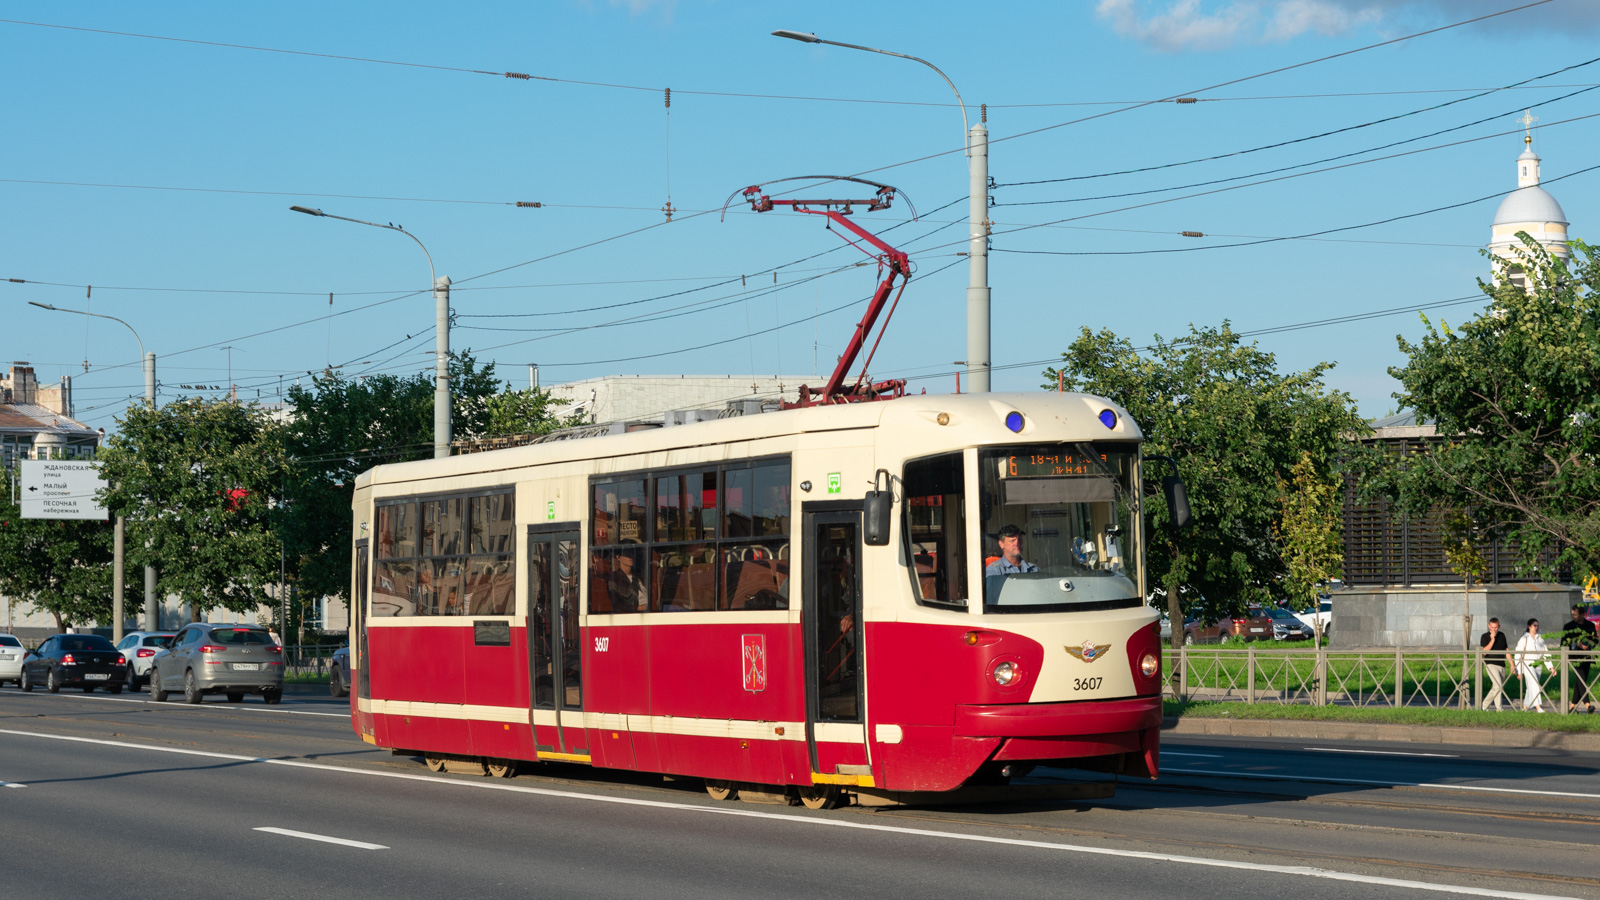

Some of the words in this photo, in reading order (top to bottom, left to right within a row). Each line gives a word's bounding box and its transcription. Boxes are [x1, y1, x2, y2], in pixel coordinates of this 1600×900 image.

[1009, 455, 1018, 476] 6
[595, 637, 609, 652] 3607
[1073, 677, 1103, 691] 3607
